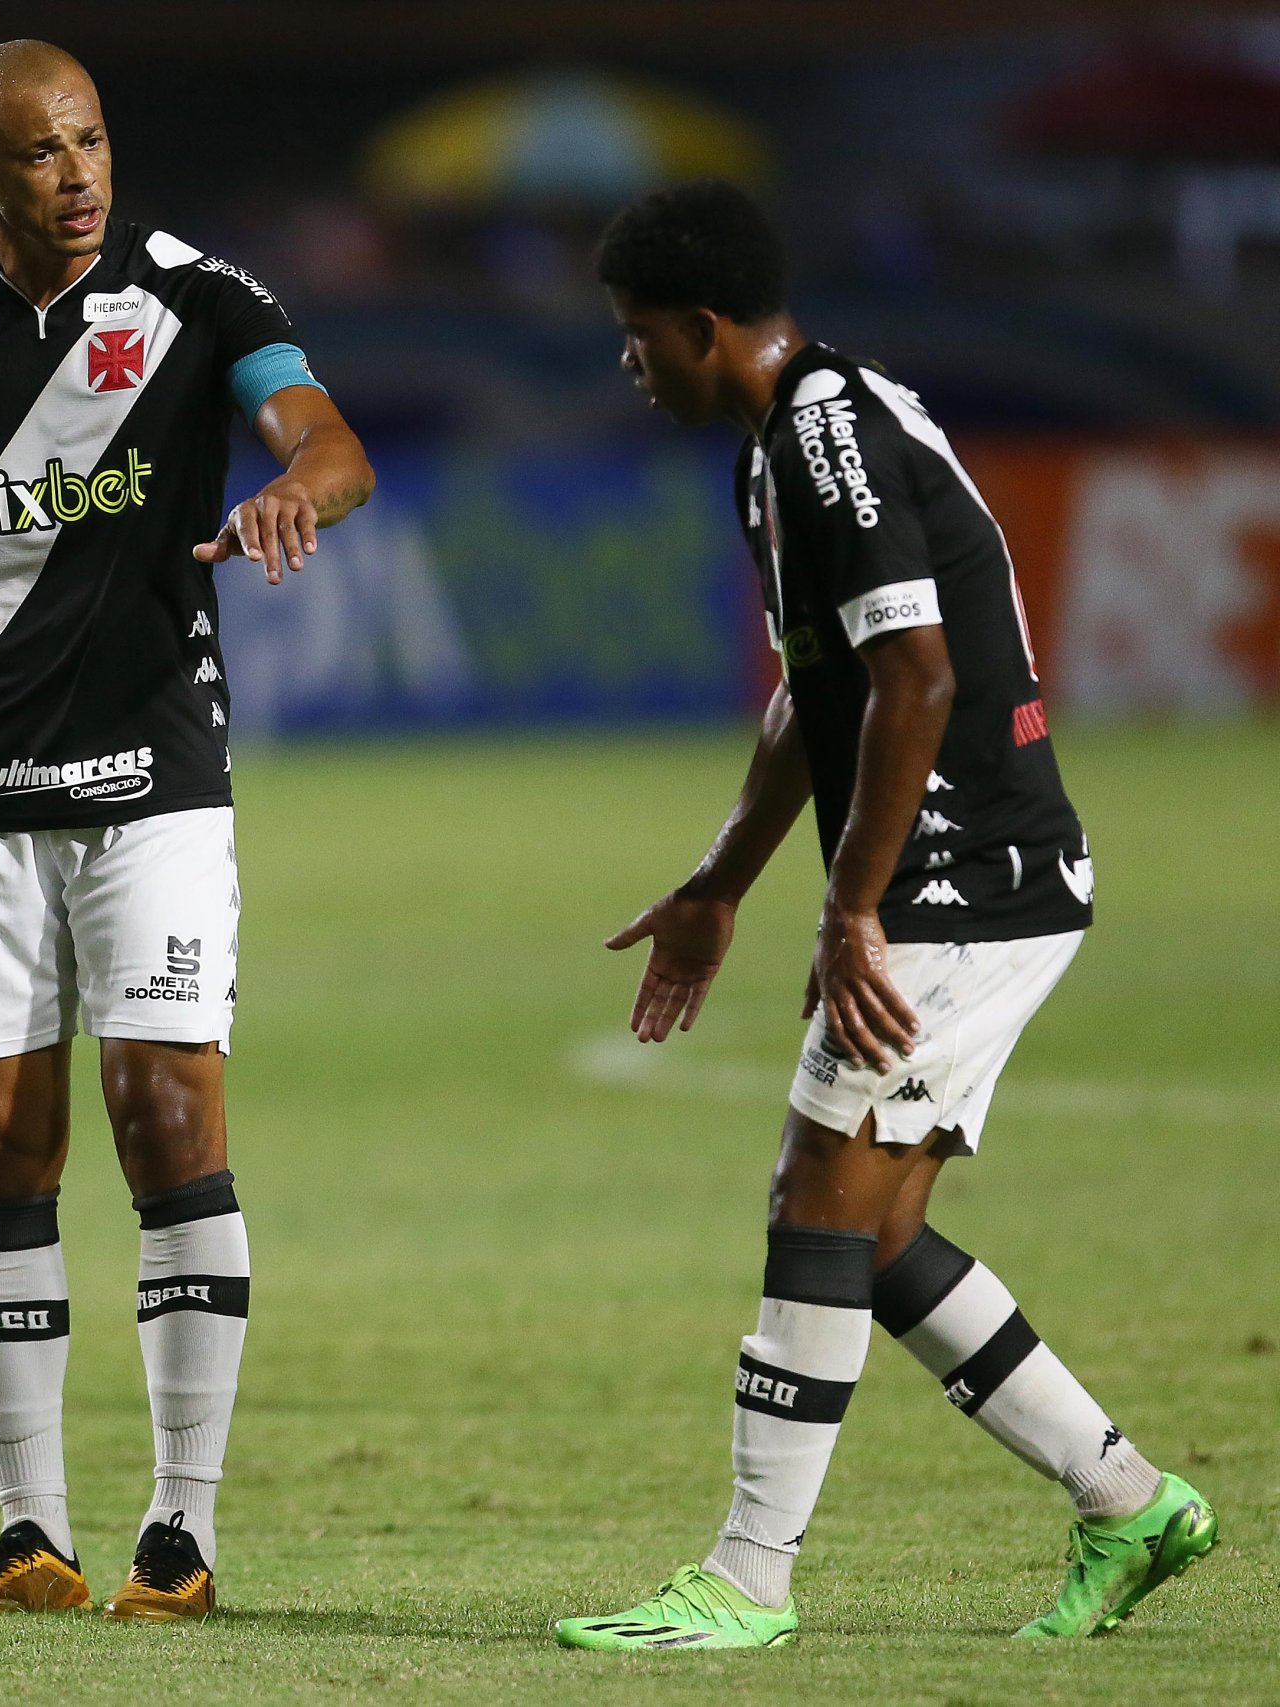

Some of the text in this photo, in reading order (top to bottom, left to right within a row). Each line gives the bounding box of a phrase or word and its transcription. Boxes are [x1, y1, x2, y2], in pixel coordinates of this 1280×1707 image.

[94, 300, 140, 313] HEBRON
[793, 404, 843, 508] Bitcoin
[823, 399, 881, 529] Mercado
[865, 602, 921, 628] TODOS
[150, 975, 200, 991] META
[124, 987, 200, 1003] SOCCER
